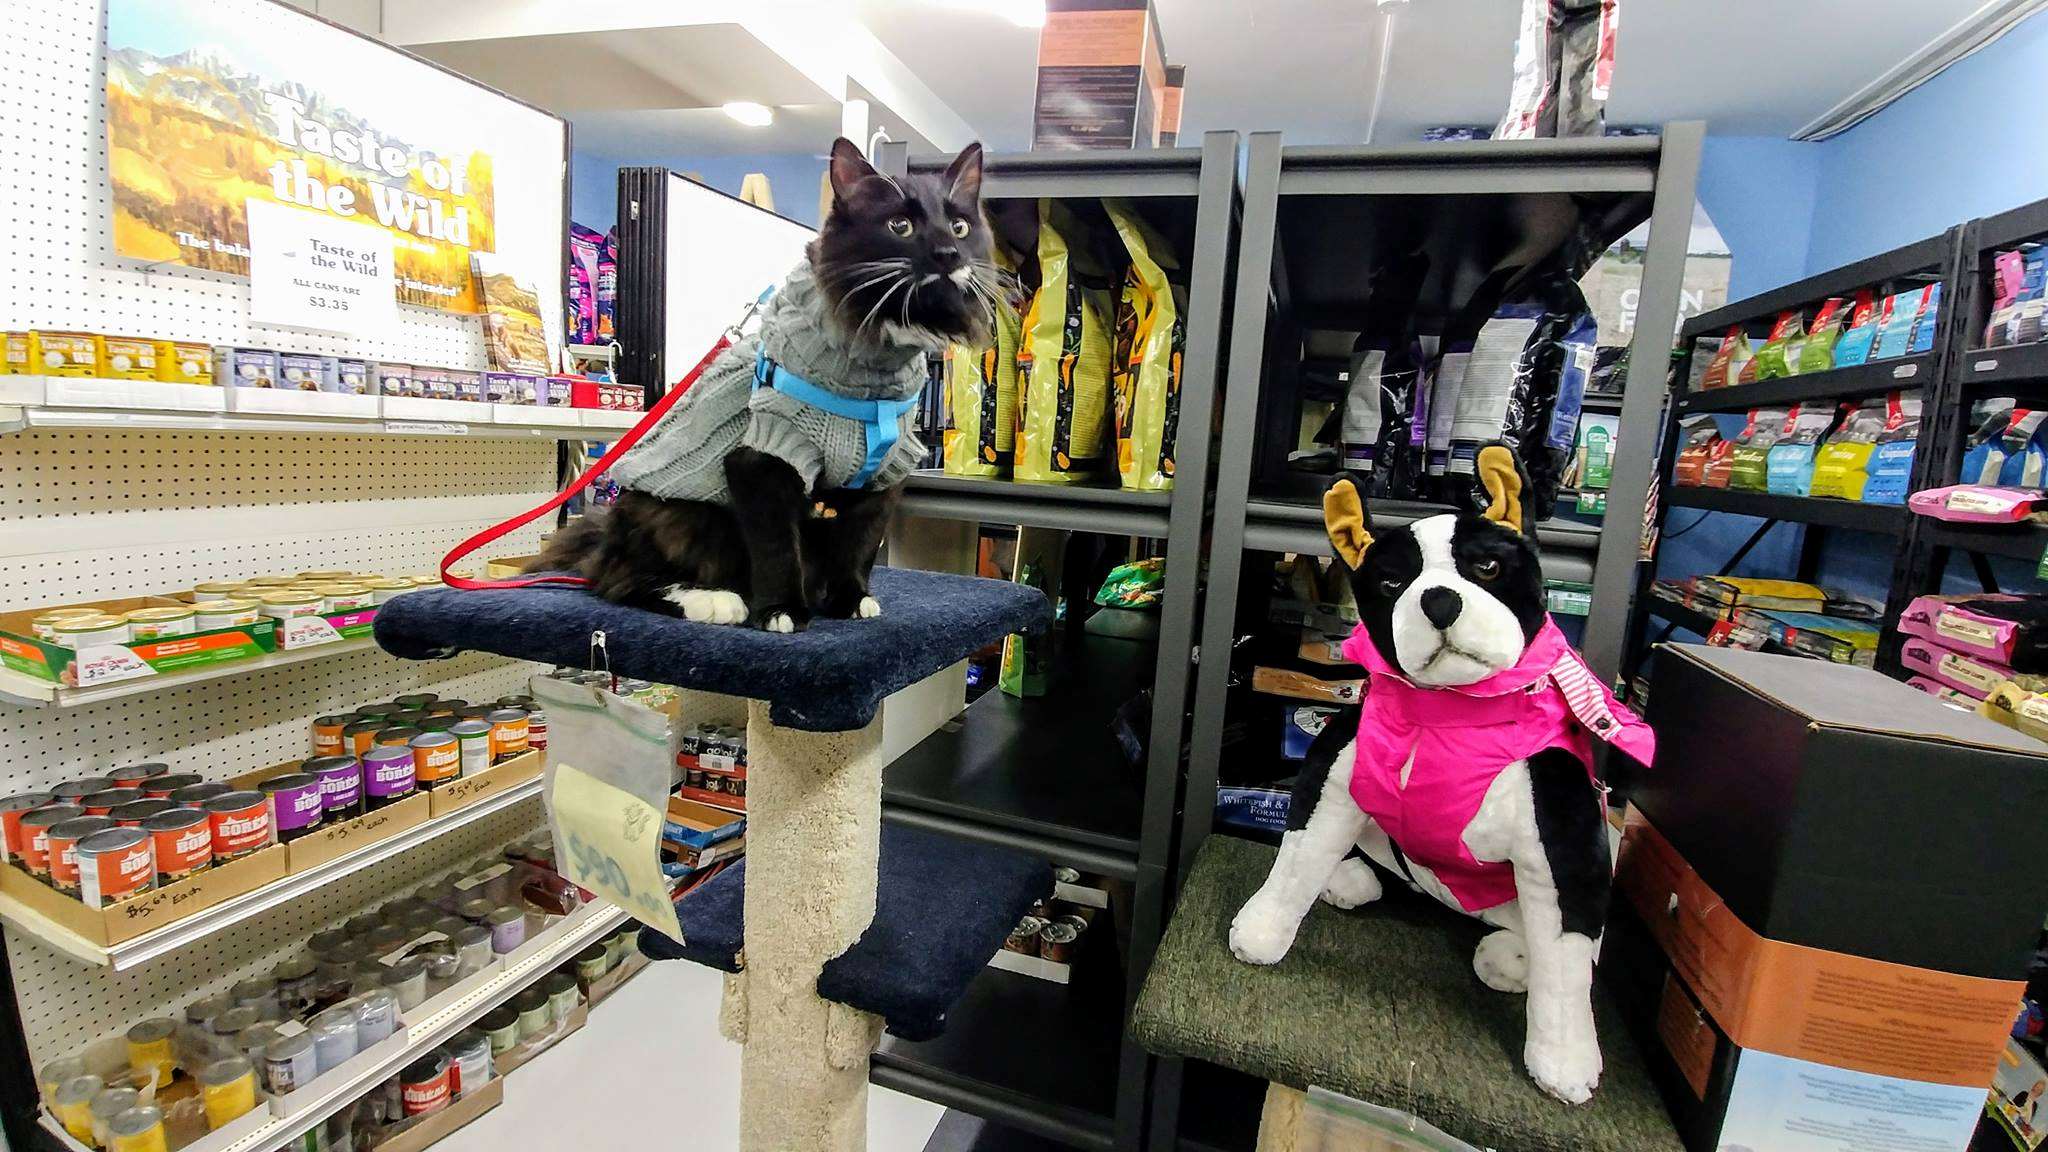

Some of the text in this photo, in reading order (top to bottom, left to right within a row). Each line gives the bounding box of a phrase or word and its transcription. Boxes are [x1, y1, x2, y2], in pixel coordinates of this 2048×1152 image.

[264, 91, 468, 196] Taste of
[269, 159, 470, 247] the Wild
[175, 231, 210, 249] The
[309, 238, 377, 263] Taste of
[310, 254, 378, 277] the Wild
[292, 278, 361, 296] ALL CANS ARE
[309, 296, 349, 311] $3.35
[1250, 806, 1288, 818] FORMUL
[172, 887, 202, 905] Each
